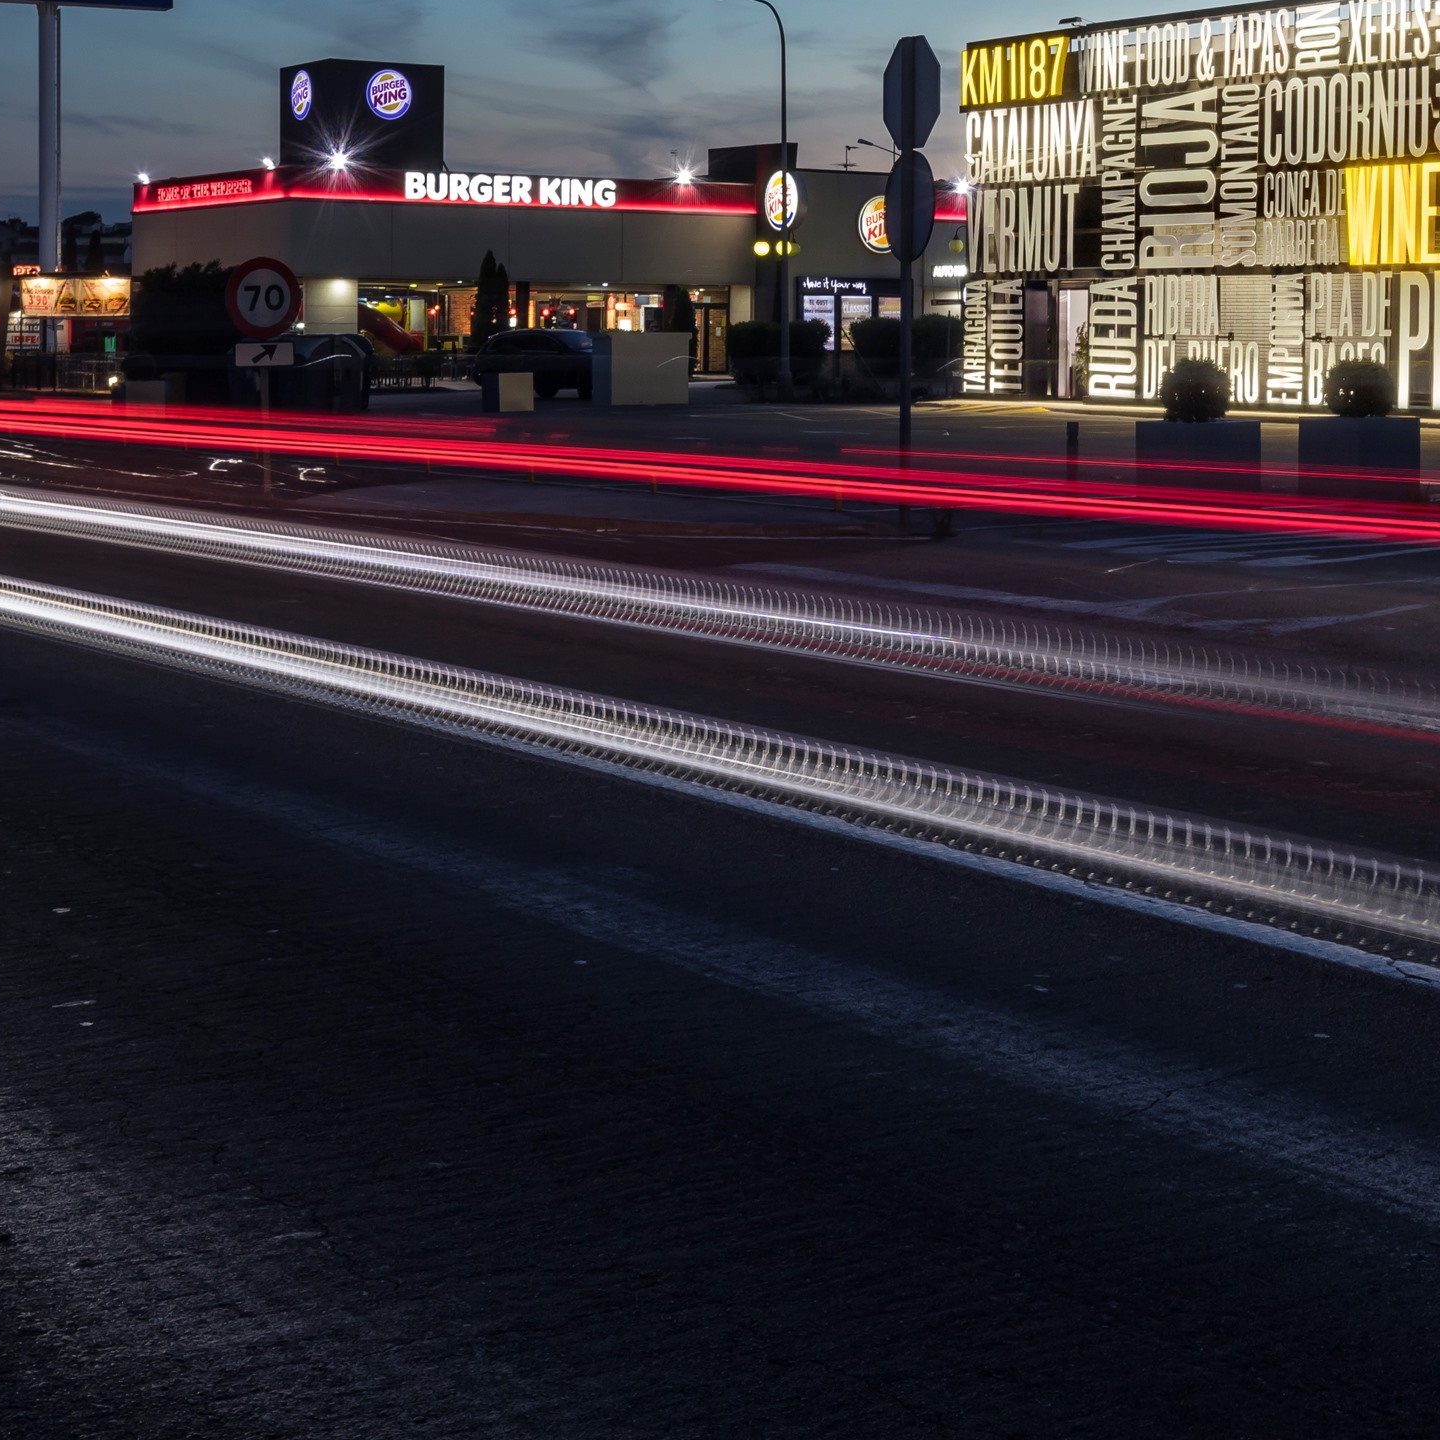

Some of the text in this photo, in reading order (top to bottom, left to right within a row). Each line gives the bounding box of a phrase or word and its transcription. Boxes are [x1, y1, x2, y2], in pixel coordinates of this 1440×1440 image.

[1078, 8, 1289, 93] WINE FOOD & TAPAS
[1295, 2, 1340, 71] RON
[372, 80, 405, 95] BURGER
[373, 88, 407, 107] KING
[962, 36, 1070, 105] KM 1187
[965, 97, 1097, 186] CATALUNYA
[1263, 65, 1429, 166] CODORNIU
[158, 179, 252, 201] HOME OF THE WHOPPER
[405, 172, 616, 207] BURGER KING
[768, 184, 791, 202] BURGR
[1101, 94, 1138, 270] CHAMPAGNE
[1139, 86, 1218, 269] RIOJA
[1219, 83, 1259, 268] SOMONTANO
[1263, 169, 1346, 219] CONCA DE
[866, 211, 886, 226] BUR
[867, 223, 887, 241] KI
[966, 184, 1079, 273] VERMUT
[1262, 219, 1339, 267] BARBERA
[243, 284, 286, 312] 70
[823, 276, 829, 290] it
[1144, 274, 1219, 335] RIBERA
[1310, 271, 1392, 336] PLA DE
[962, 279, 987, 393] TARRAGONA
[989, 279, 1023, 393] TEQUILA
[1088, 276, 1138, 398] RUEDA
[1267, 273, 1303, 405] EMPORDA
